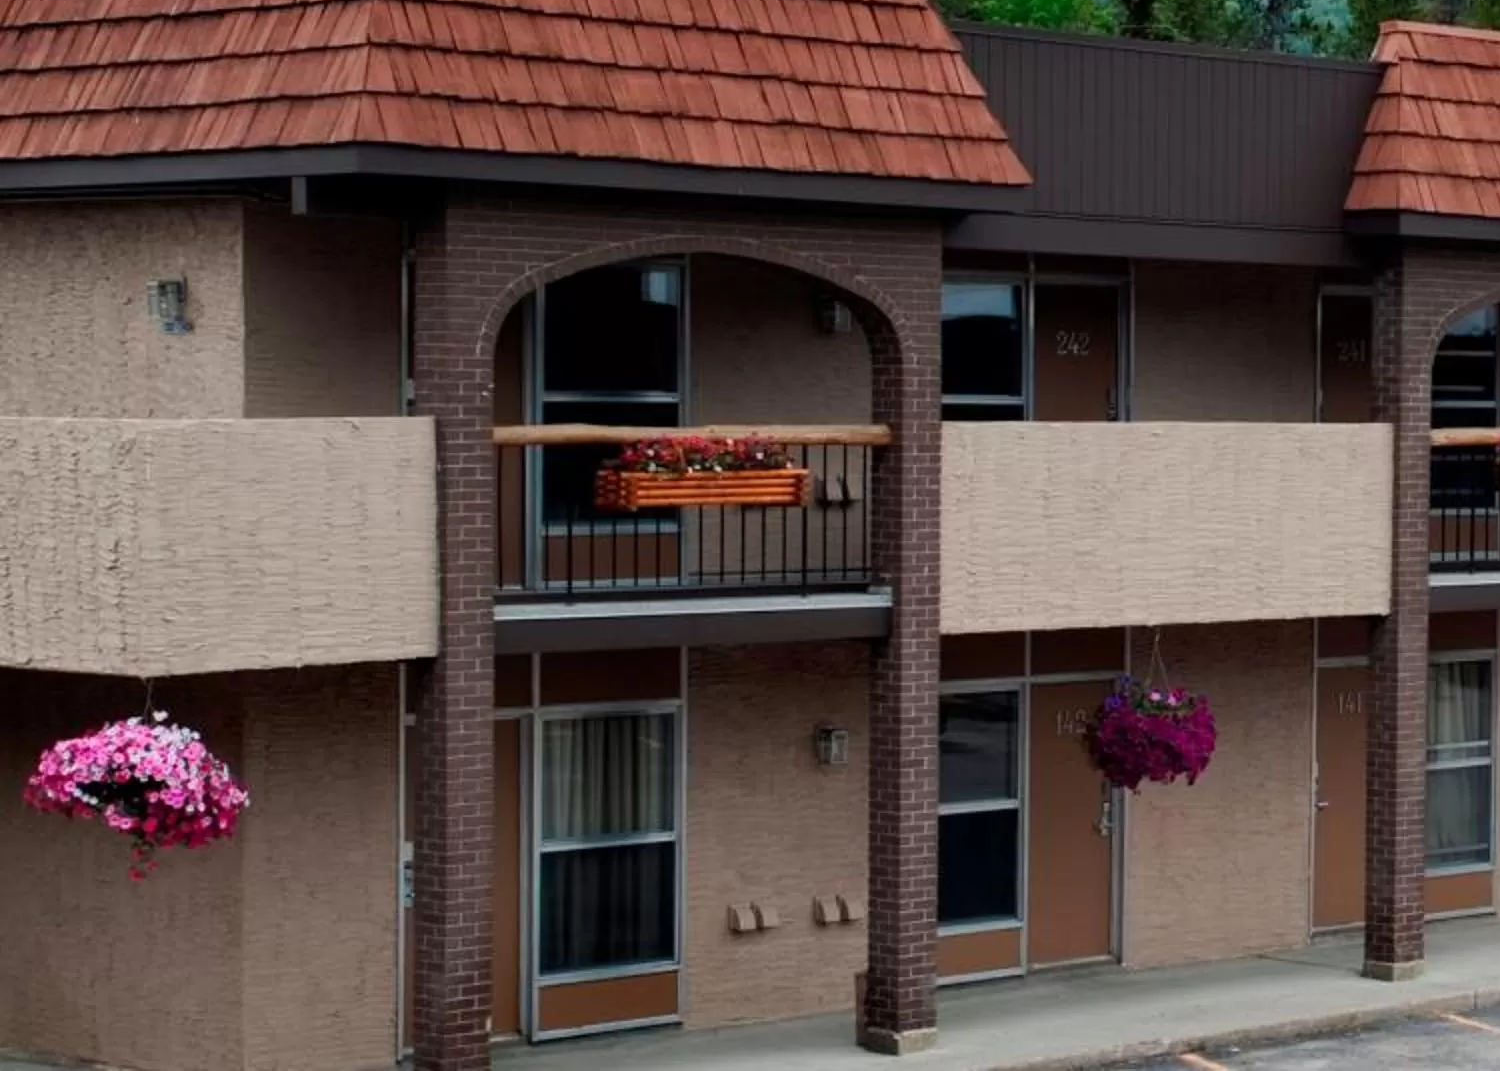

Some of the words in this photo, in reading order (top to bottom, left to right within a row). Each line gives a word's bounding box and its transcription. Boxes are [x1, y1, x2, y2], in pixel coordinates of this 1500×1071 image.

[1056, 330, 1090, 356] 242
[1336, 337, 1365, 362] 241
[1338, 690, 1361, 714] 141
